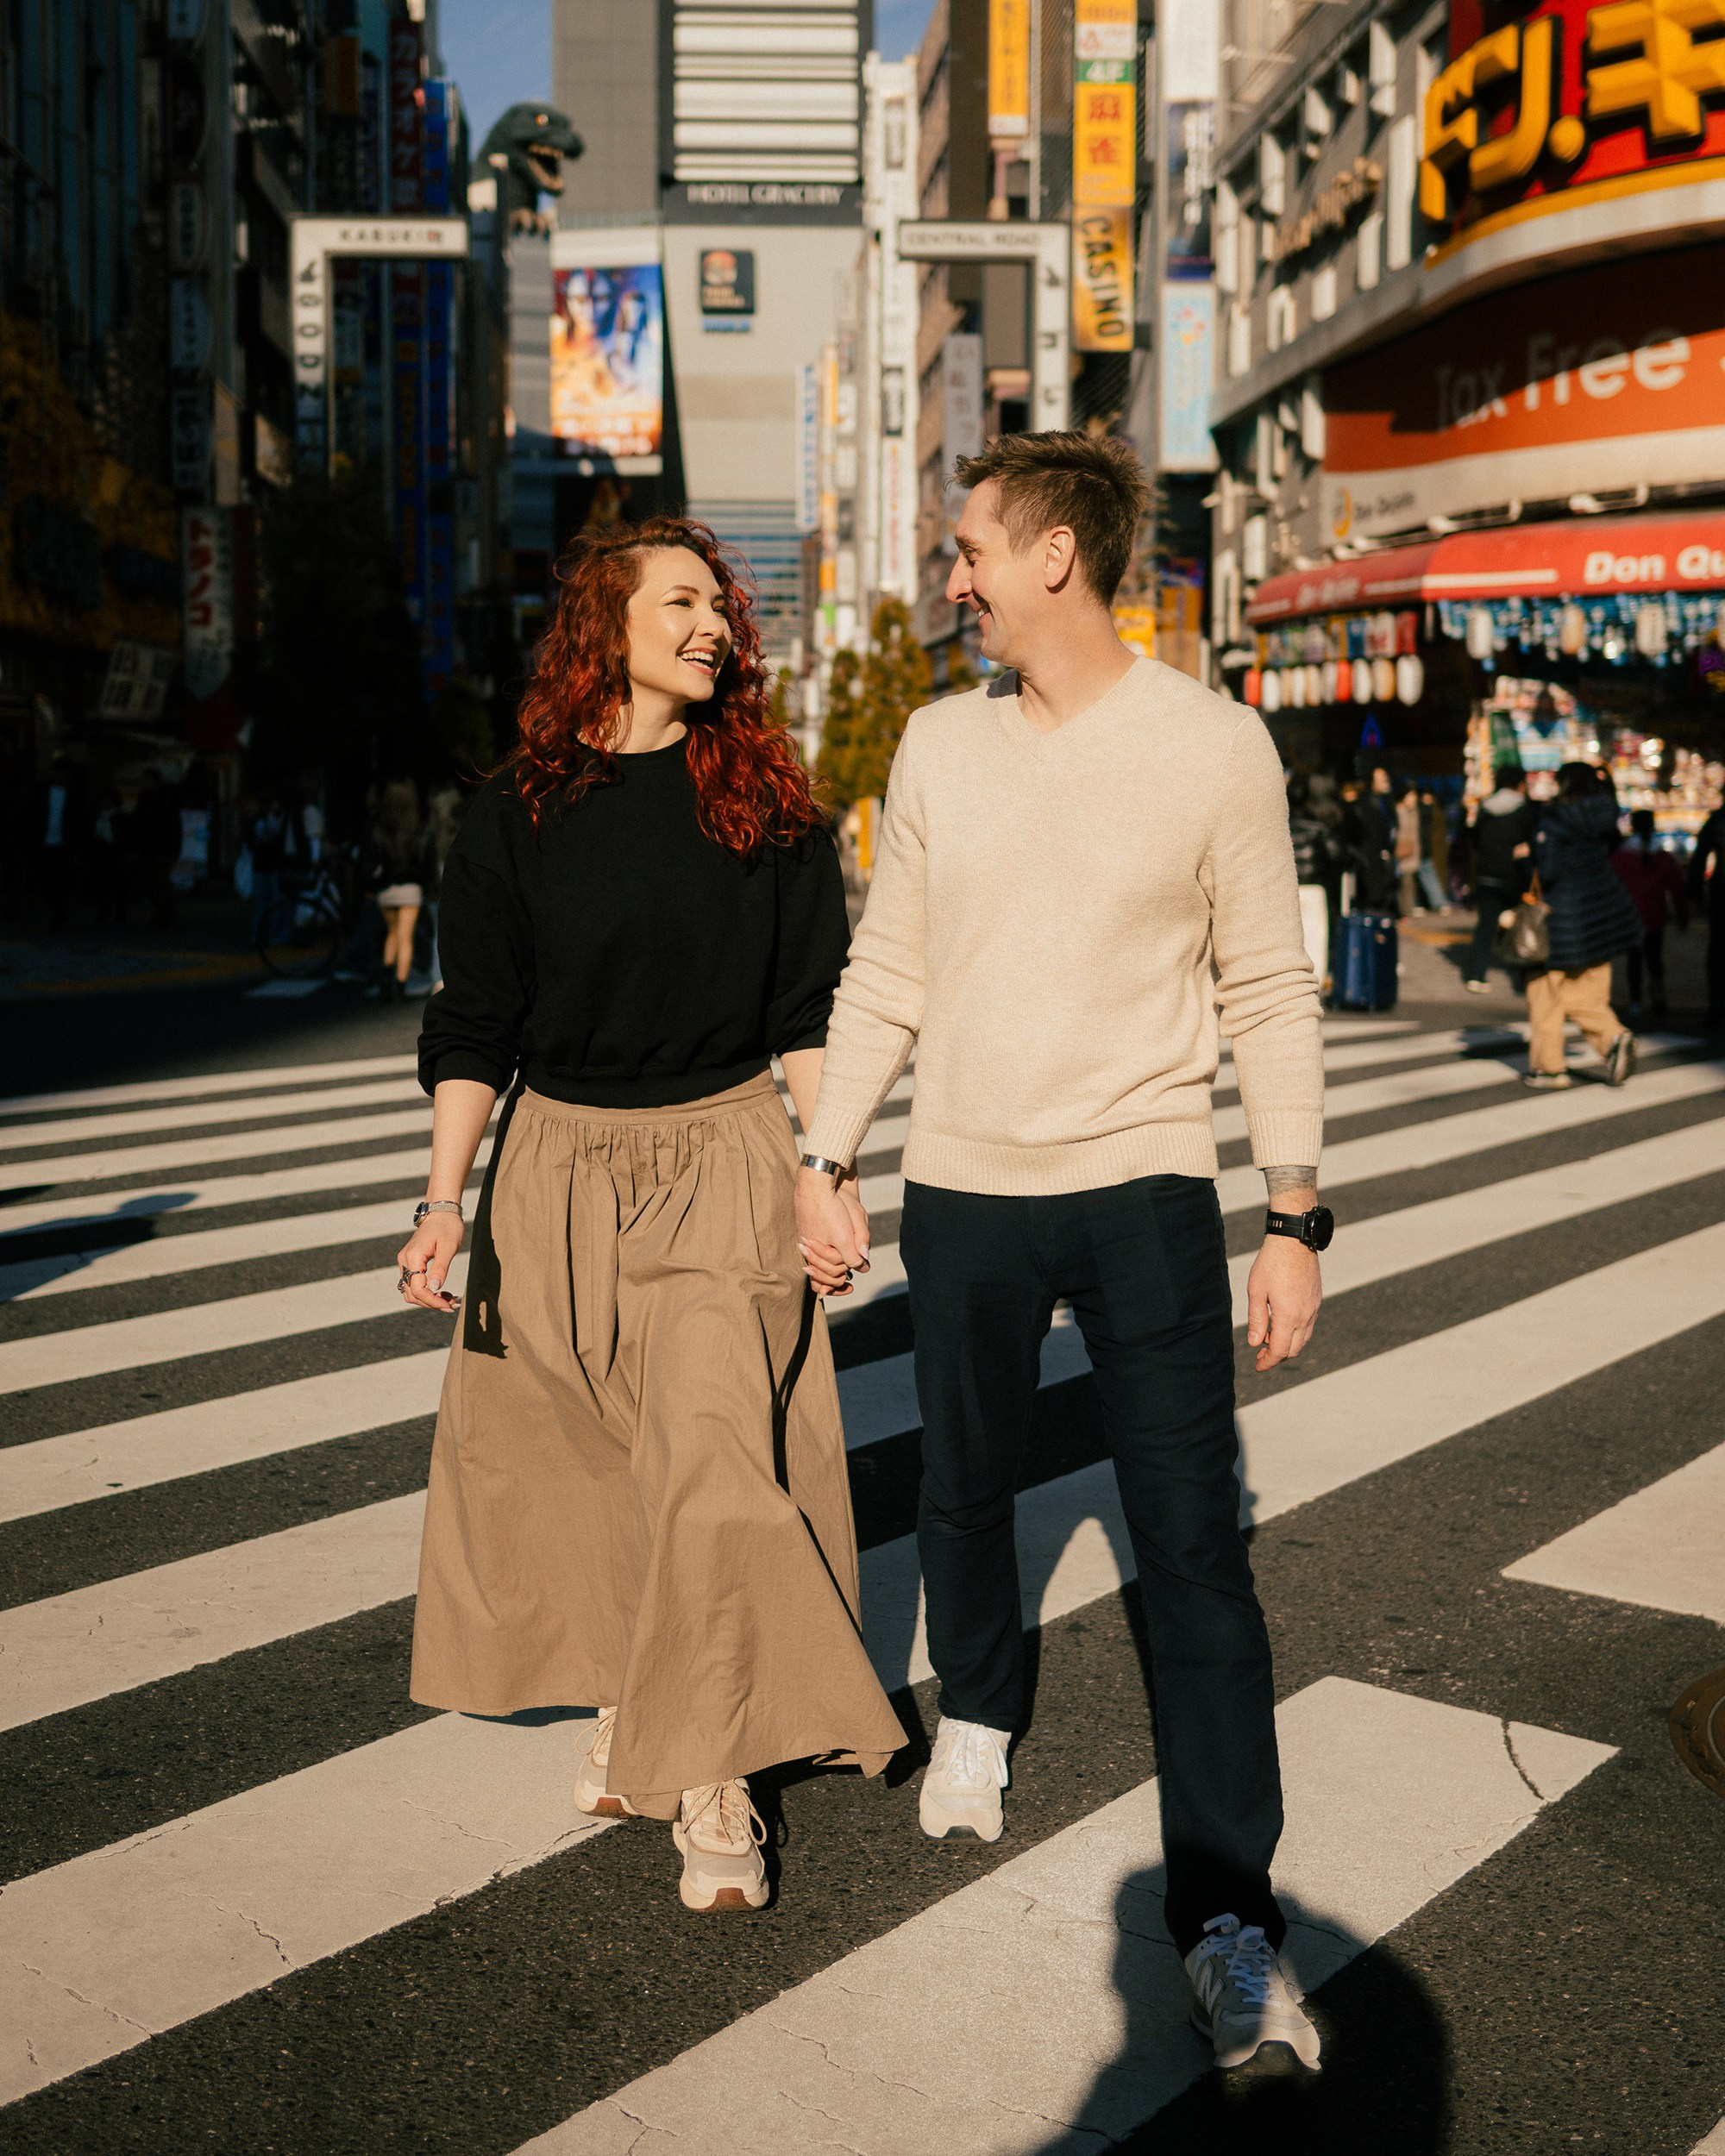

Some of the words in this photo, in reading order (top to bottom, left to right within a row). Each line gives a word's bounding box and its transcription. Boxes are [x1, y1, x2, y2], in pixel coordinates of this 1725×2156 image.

[1086, 60, 1126, 83] 4F
[687, 184, 750, 205] HOTEL
[1082, 216, 1126, 338] CASINO
[1435, 357, 1509, 433] Tax
[1523, 325, 1692, 412] Free
[1584, 550, 1665, 586] Don
